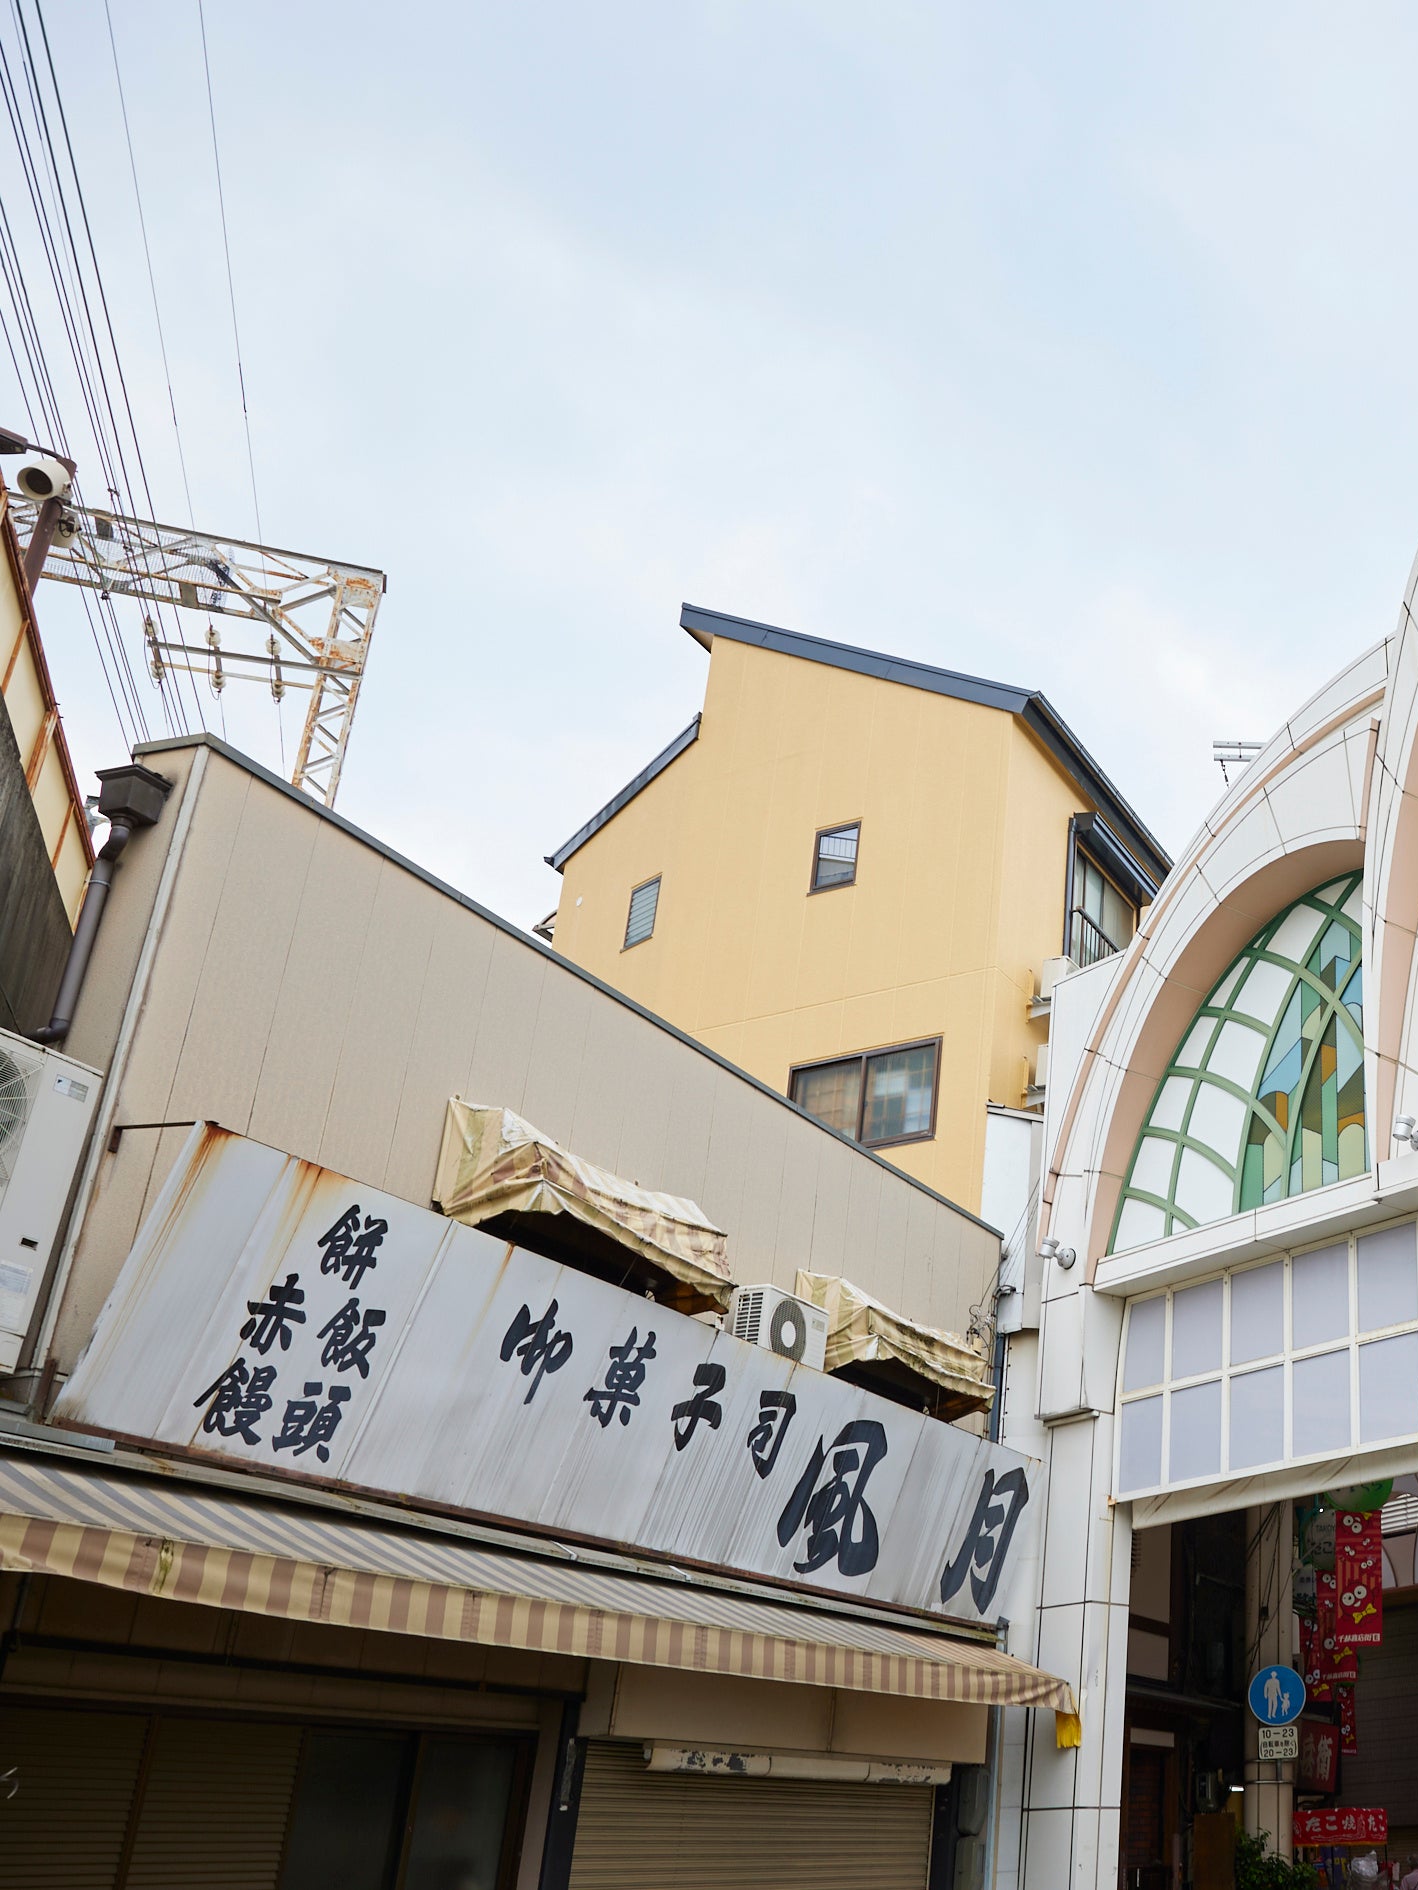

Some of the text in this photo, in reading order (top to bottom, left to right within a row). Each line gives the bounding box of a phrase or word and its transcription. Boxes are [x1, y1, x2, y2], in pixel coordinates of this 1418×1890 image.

[240, 1273, 387, 1380] 赤飯
[193, 1357, 352, 1462] 饅頭
[777, 1418, 1029, 1615] 風月
